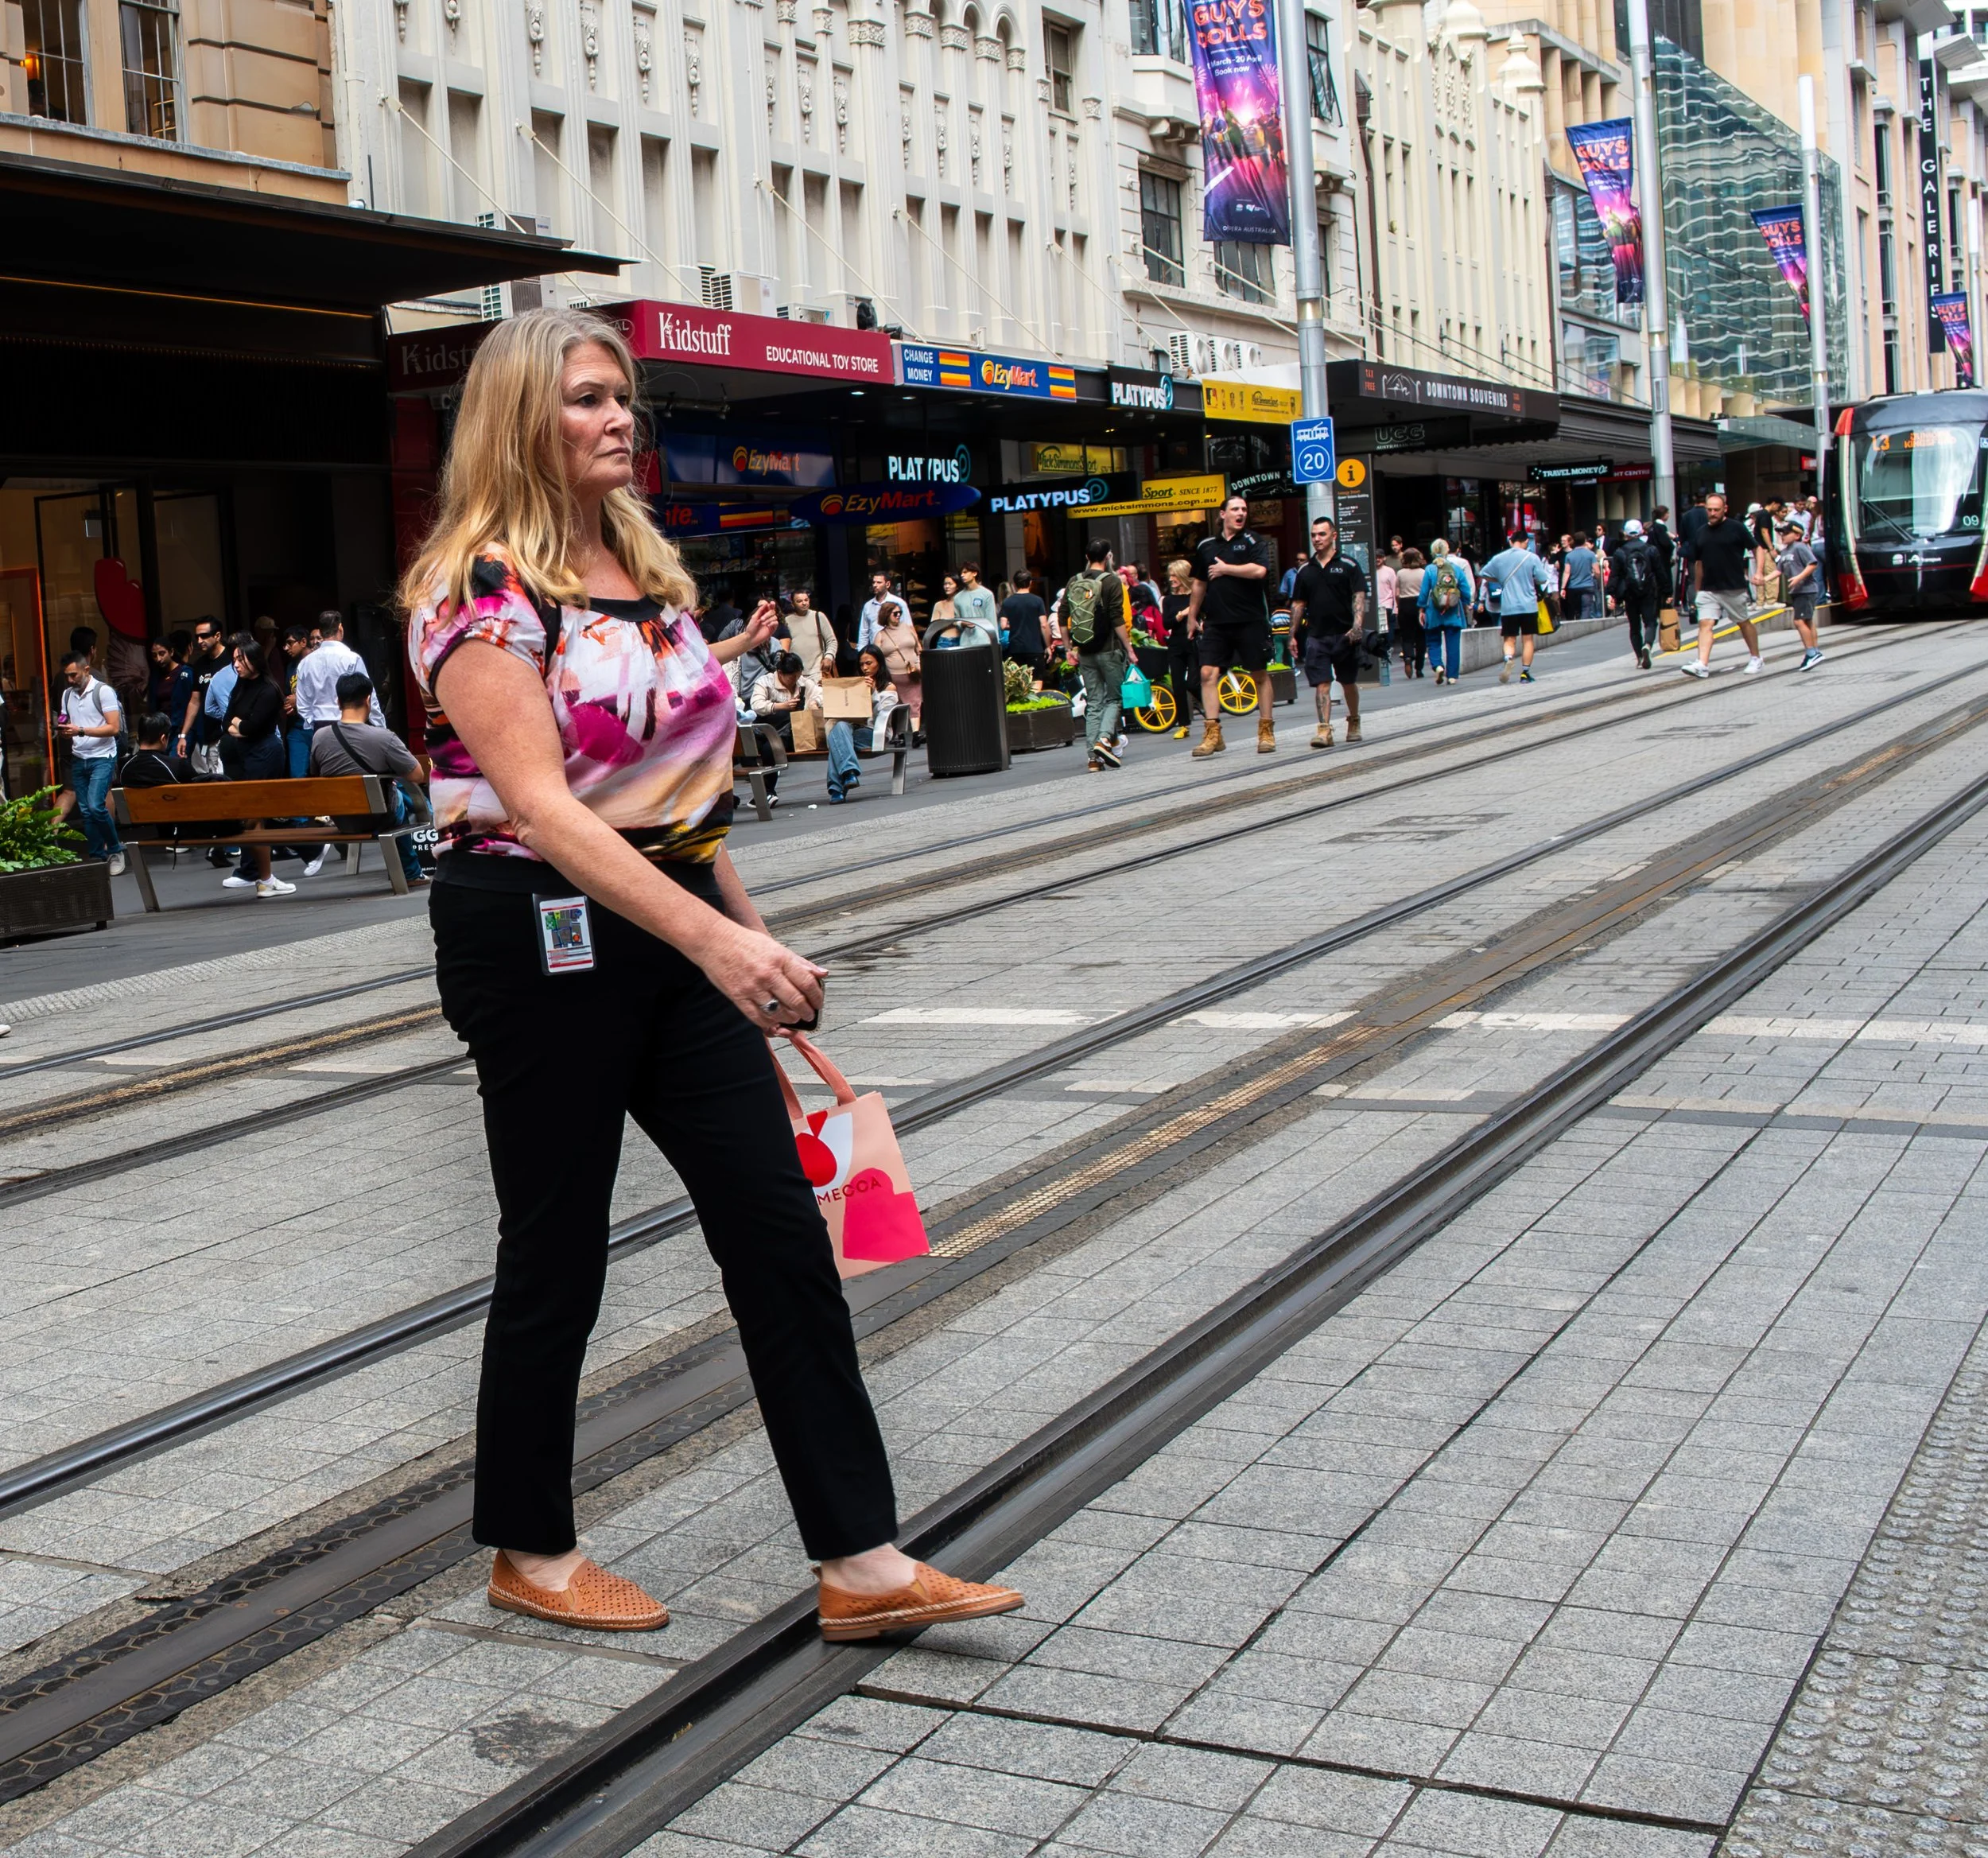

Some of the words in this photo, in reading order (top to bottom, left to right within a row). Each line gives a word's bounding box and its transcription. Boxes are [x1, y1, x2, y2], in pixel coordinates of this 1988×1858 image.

[1194, 0, 1265, 26] GUYS
[1225, 17, 1233, 25] &
[1214, 68, 1233, 76] Book
[1920, 76, 1932, 133] THE
[1576, 139, 1628, 159] GUYS
[658, 311, 732, 356] Kidstuff
[766, 345, 831, 369] EDUCATIONAL
[832, 354, 850, 371] TOY
[851, 356, 879, 374] STORE
[903, 348, 934, 364] CHANGE
[907, 367, 933, 382] MONEY
[1112, 381, 1167, 410] PLATYPUS
[1427, 381, 1468, 401] DOWNTOWN
[1470, 387, 1508, 408] SOUVENIRS
[1871, 433, 1890, 452] L3
[1303, 452, 1326, 471] 20
[1231, 471, 1280, 491] DOWNTOWN
[1543, 468, 1571, 477] TRAVEL
[1571, 466, 1598, 475] MONEY
[991, 488, 1090, 513] PLATYPUS
[1073, 498, 1217, 514] www.micksimmons.com.au
[1963, 515, 1979, 527] 09
[412, 828, 439, 843] GG
[817, 1176, 882, 1206] MECCA
